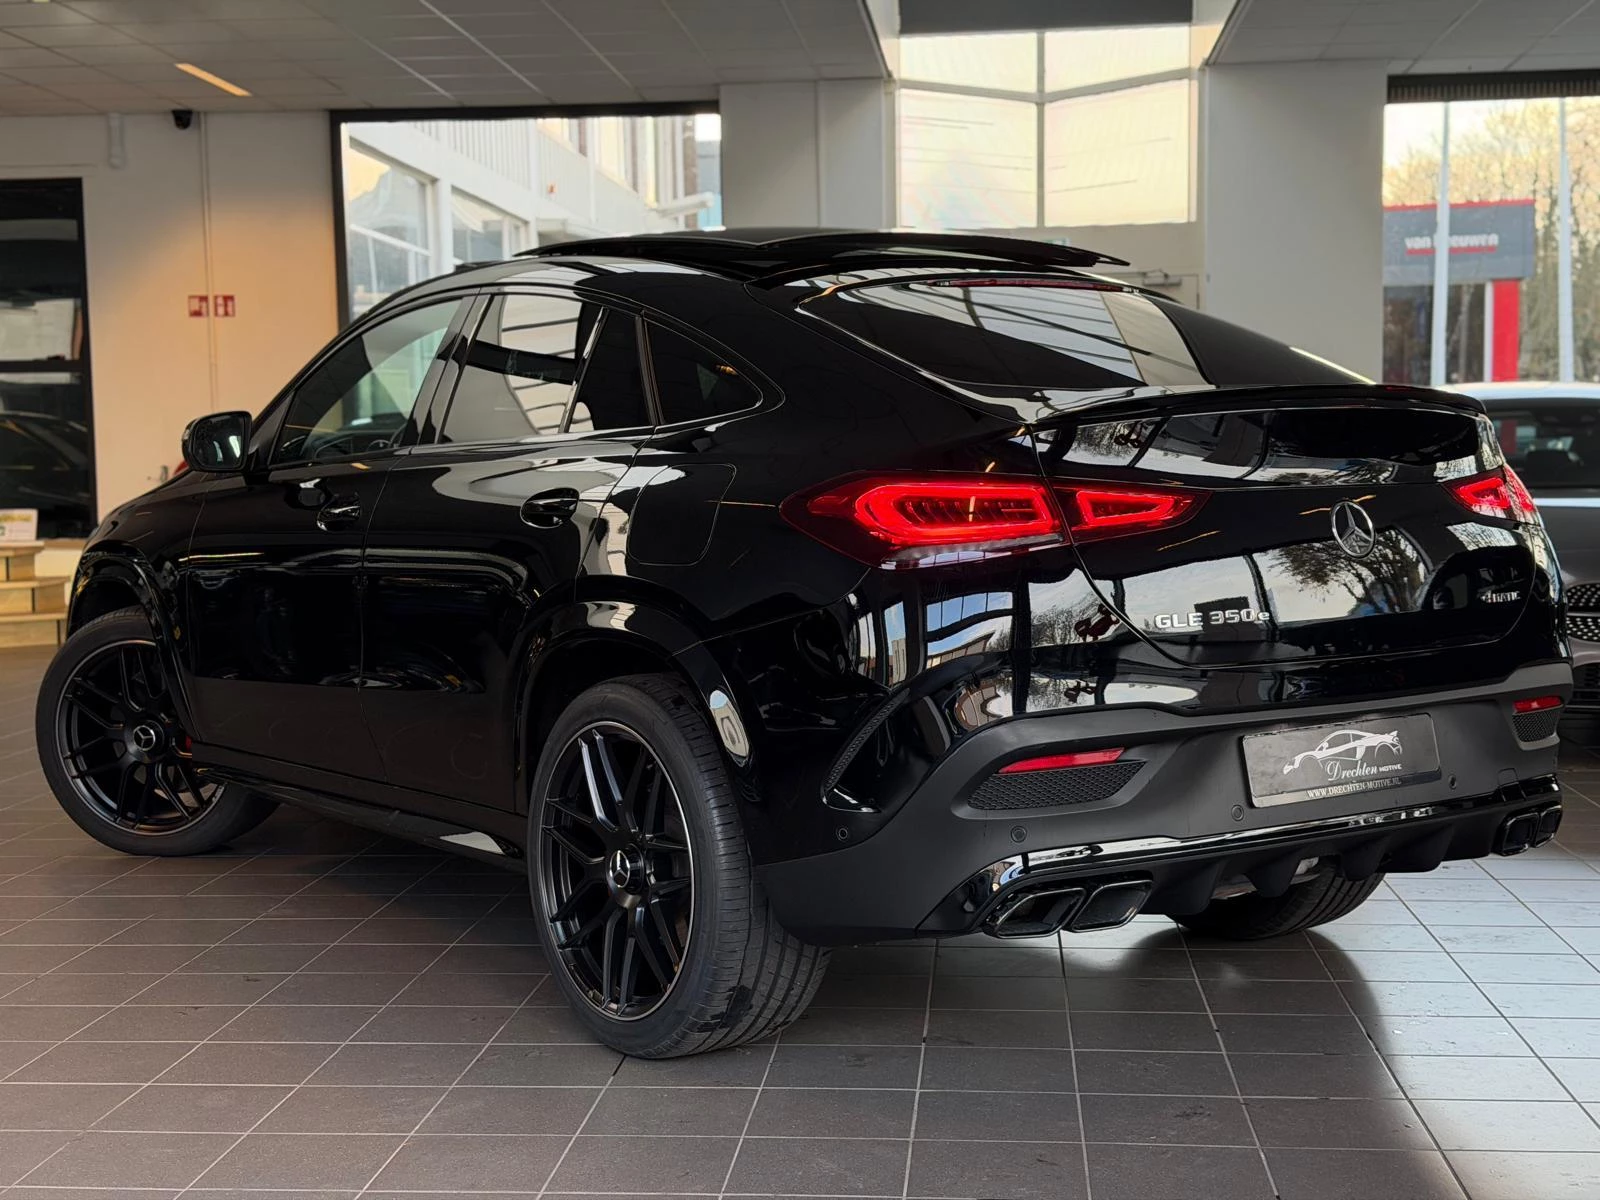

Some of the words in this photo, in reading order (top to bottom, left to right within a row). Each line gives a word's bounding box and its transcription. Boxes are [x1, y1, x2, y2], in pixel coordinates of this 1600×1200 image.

[1154, 612, 1203, 629] GLE
[1209, 608, 1270, 625] 350e
[1325, 760, 1378, 781] Drechten
[1379, 763, 1402, 772] MOTIVE
[1307, 777, 1402, 798] WWW.DRECHTEN-MOTIVE.NL
